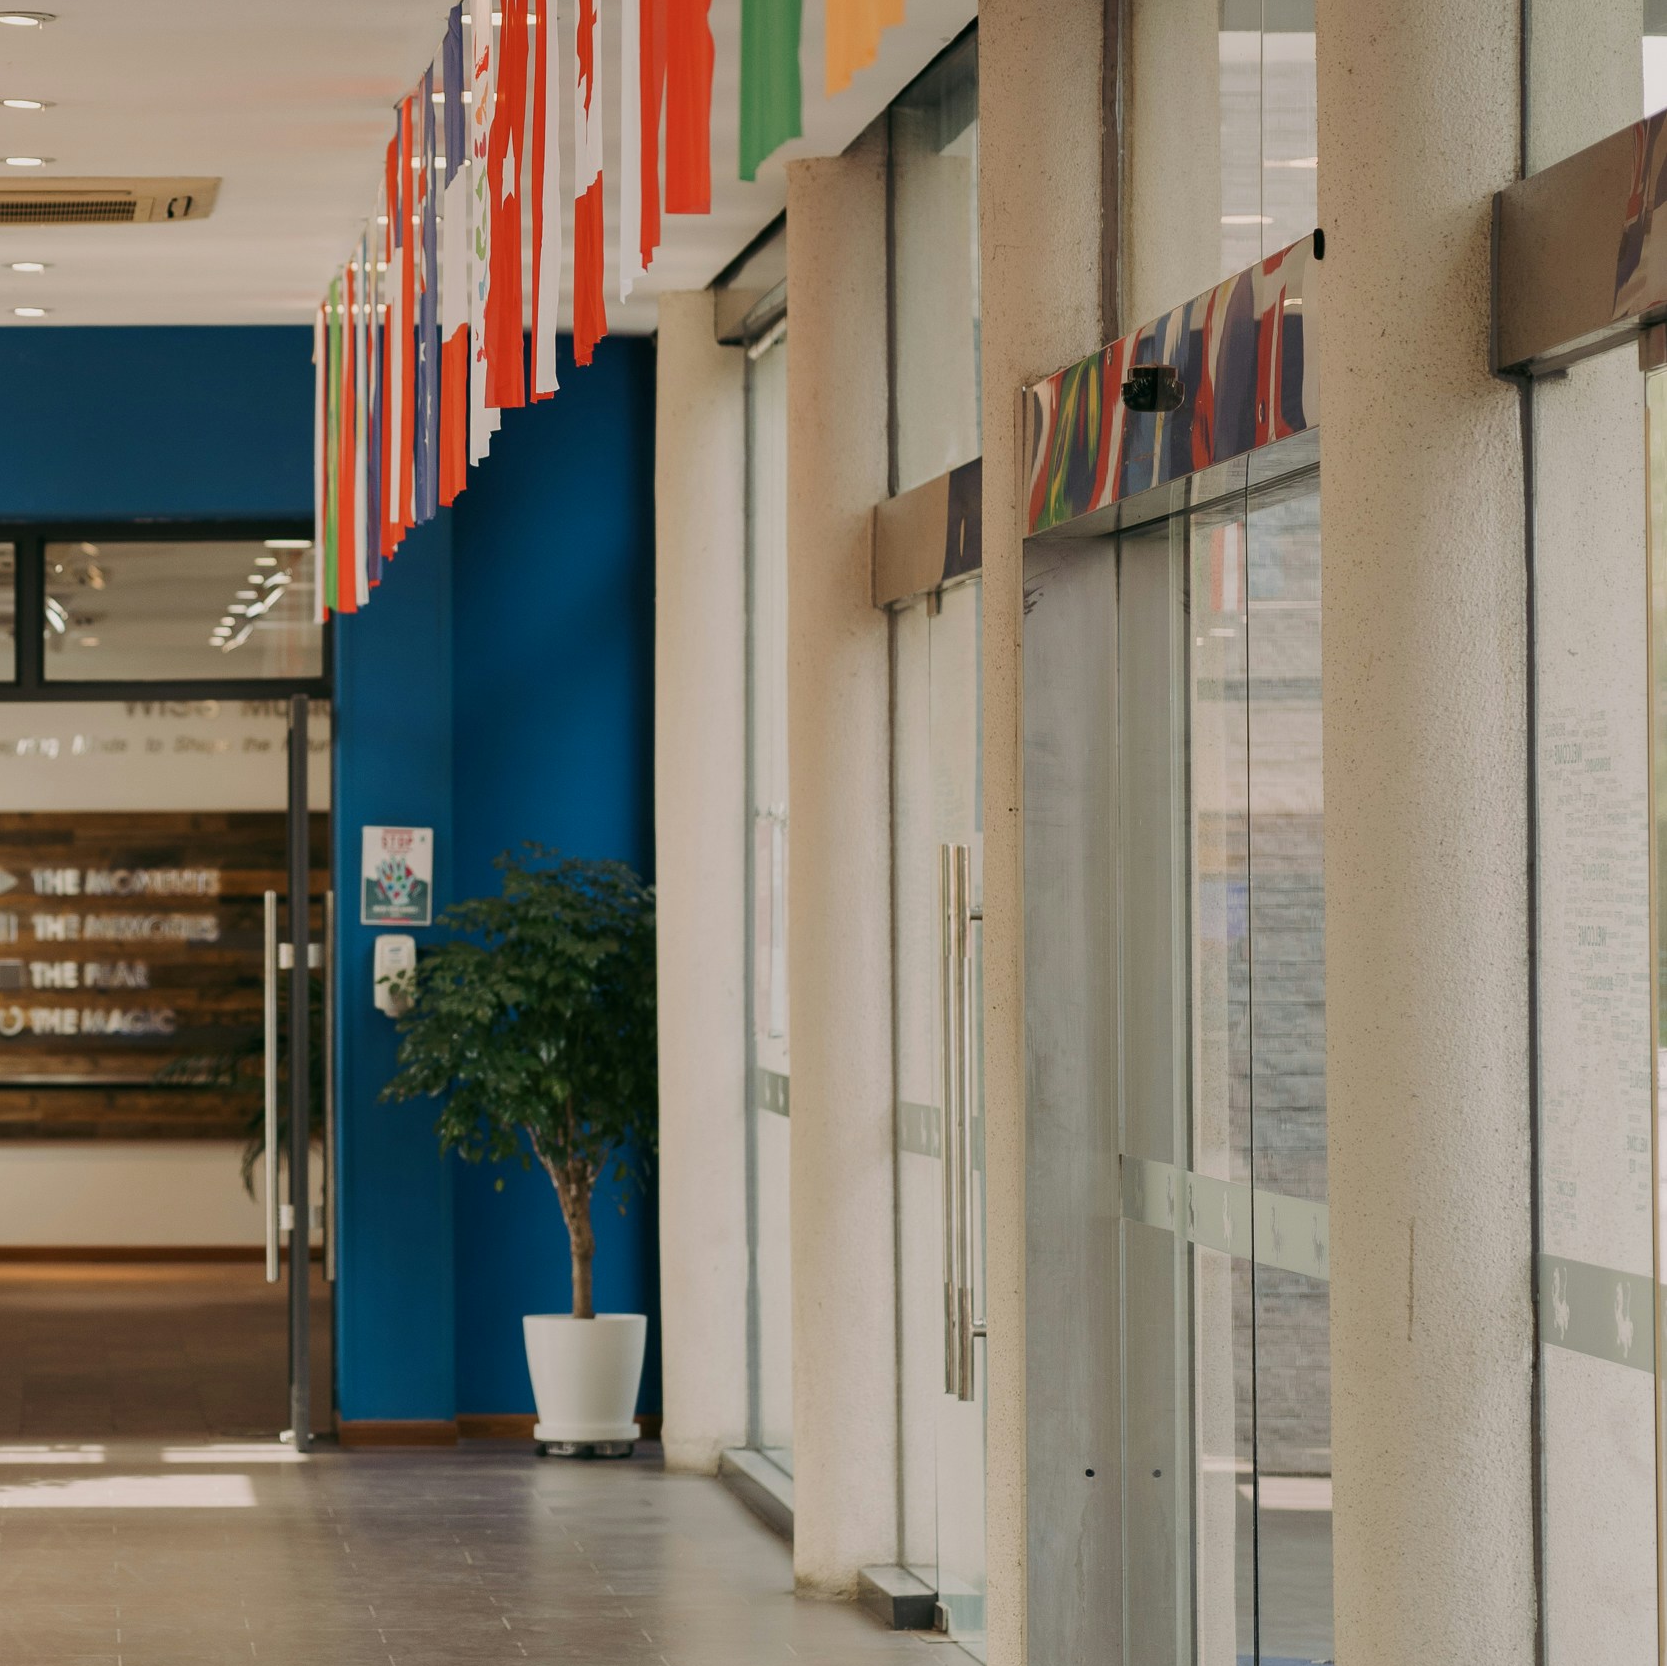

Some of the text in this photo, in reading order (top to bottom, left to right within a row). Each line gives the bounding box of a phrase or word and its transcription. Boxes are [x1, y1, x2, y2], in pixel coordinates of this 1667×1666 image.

[30, 869, 81, 896] THE
[31, 913, 81, 942] THE
[29, 961, 80, 989] THE
[29, 1007, 80, 1036] THE
